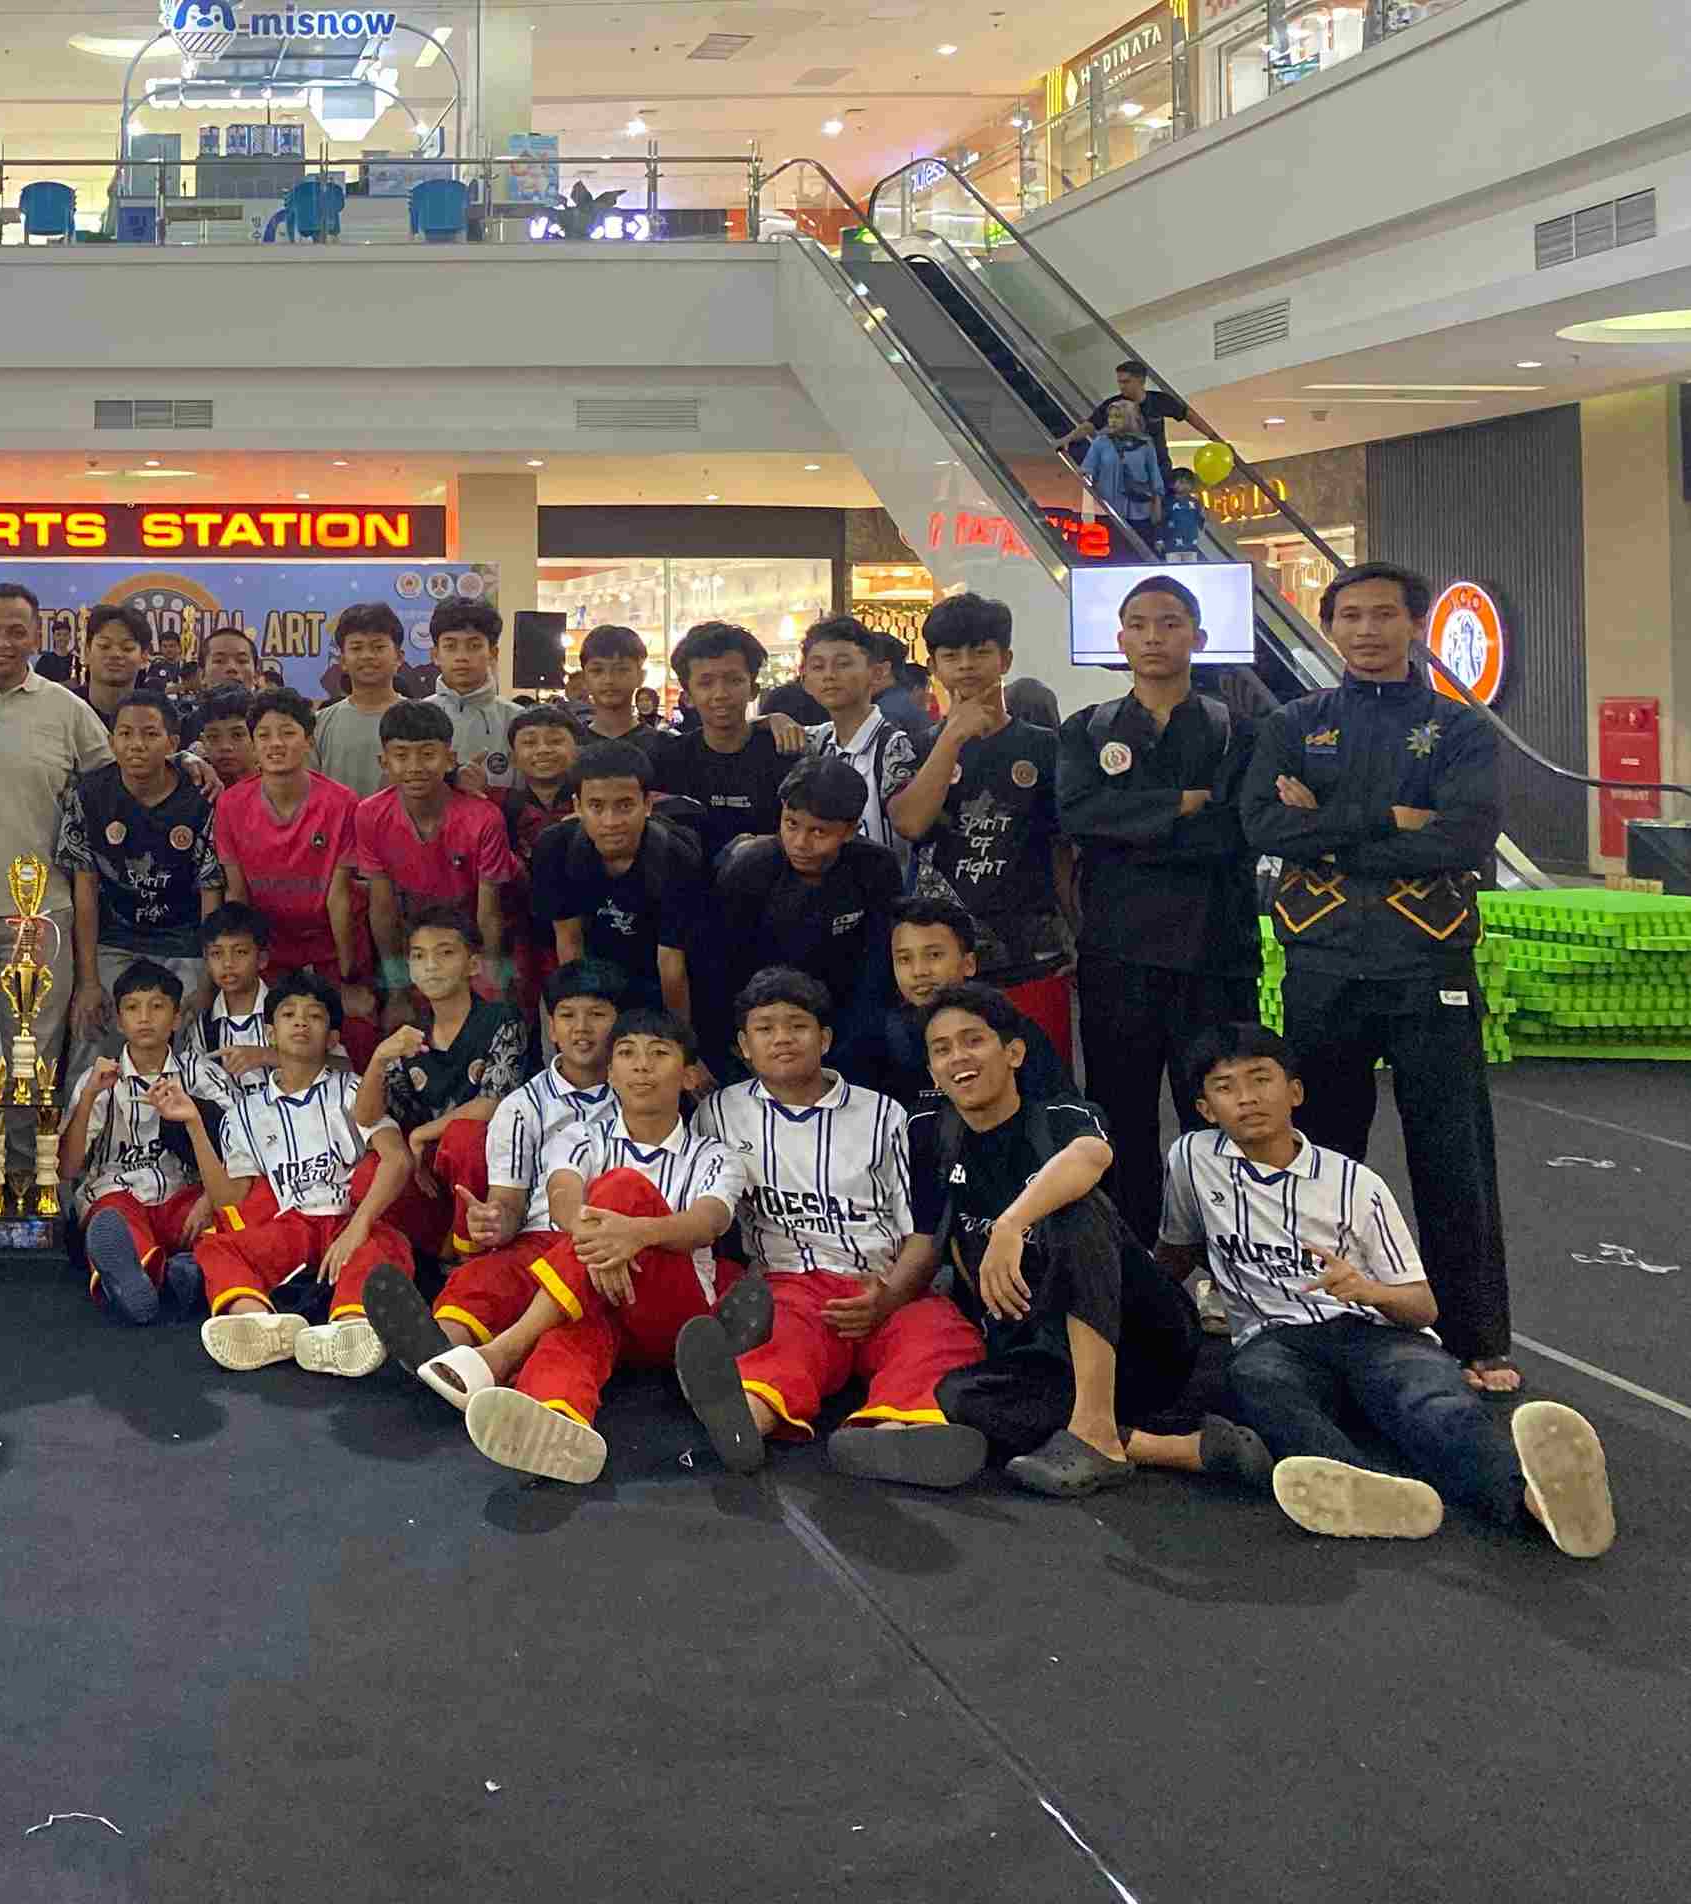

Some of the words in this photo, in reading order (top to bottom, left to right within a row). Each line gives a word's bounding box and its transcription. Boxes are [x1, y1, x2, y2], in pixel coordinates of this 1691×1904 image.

[249, 2, 396, 38] misnow
[1080, 25, 1162, 86] HDINATA
[142, 512, 410, 547] STATION
[264, 609, 326, 658] ART
[741, 1184, 868, 1222] MOESAL
